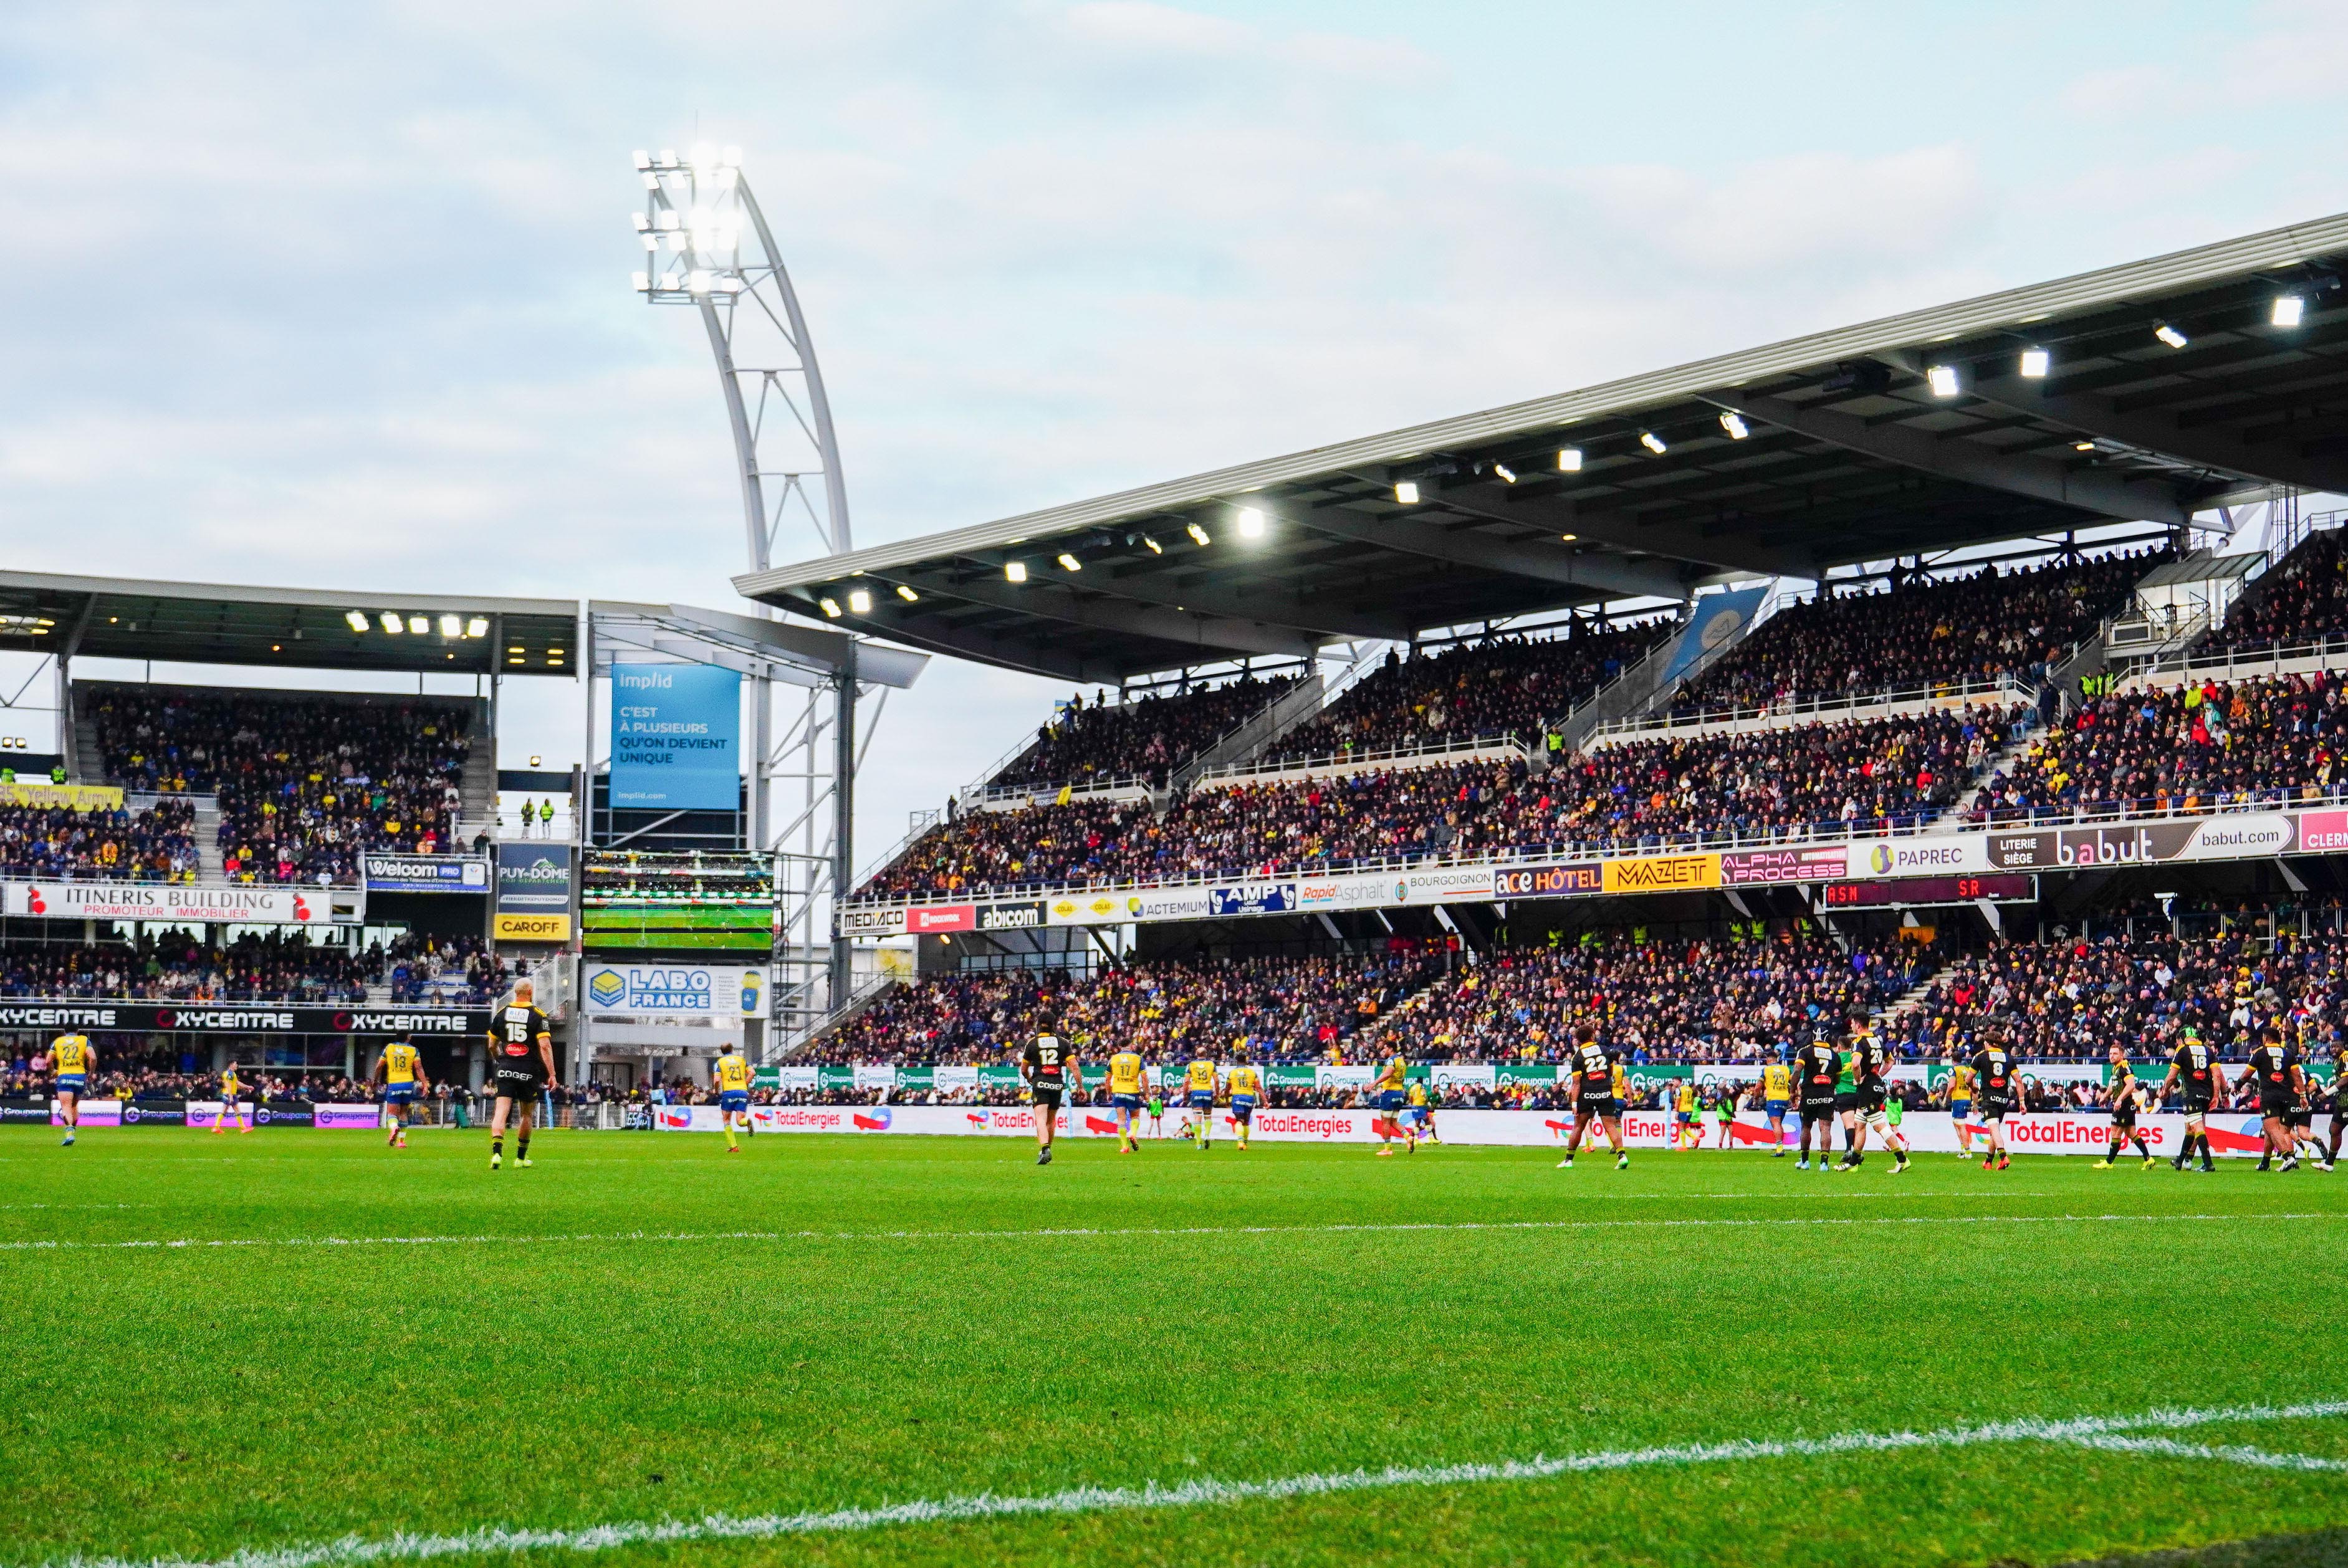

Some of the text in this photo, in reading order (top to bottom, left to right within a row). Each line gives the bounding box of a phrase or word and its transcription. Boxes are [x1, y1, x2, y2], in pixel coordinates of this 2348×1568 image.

[620, 672, 673, 688] implid
[620, 707, 658, 717] C'EST
[633, 724, 709, 734] PLUSIEURS
[620, 738, 727, 748] QU'ON DEVIENT
[620, 753, 673, 765] UNIQUE
[618, 791, 666, 800] implid.com
[2000, 839, 2037, 851] LITERIE
[2202, 830, 2279, 846] babut.com
[2057, 829, 2153, 865] babut
[1722, 851, 1796, 868] ALPHA
[1899, 848, 1962, 866] PAPREC
[2004, 851, 2033, 864] SIÈGE
[368, 860, 438, 877] Welcom
[1618, 858, 1707, 887] MAZET
[1734, 863, 1845, 882] PROCESS
[1411, 873, 1491, 887] BOURGOIGNON
[1497, 868, 1601, 894] ace HÔTEL
[1226, 886, 1278, 902] AMP
[1828, 886, 1857, 902] ASM
[1959, 880, 1978, 896] SR
[67, 889, 274, 909] ITINERIS BUILDING
[84, 905, 249, 918] PROMOTEUR IMMOBILIER
[1147, 901, 1207, 915] ACTEMIUM
[984, 906, 1038, 927] abicom
[502, 921, 559, 933] CAROFF
[630, 970, 710, 991] LABO
[630, 993, 710, 1008] FRANCE
[506, 1023, 527, 1042] 15
[63, 1046, 78, 1059] 22
[1039, 1049, 1058, 1065] 12
[1870, 1049, 1882, 1064] 20
[393, 1056, 406, 1068] 13
[1584, 1056, 1608, 1073] 22
[1819, 1059, 1829, 1073] 7
[1993, 1062, 2003, 1076] 8
[2192, 1055, 2207, 1069] 18
[2273, 1057, 2282, 1071] 5
[499, 1069, 532, 1081] COGEP
[729, 1066, 742, 1079] 21
[828, 1075, 854, 1084] Groupama
[868, 1075, 893, 1084] Groupama
[906, 1074, 933, 1084] Groupama
[947, 1074, 975, 1084] Groupama
[990, 1074, 1018, 1084] Groupama
[791, 1076, 815, 1084] Groupama
[1037, 1081, 1063, 1090] COGEP
[1278, 1074, 1315, 1086] Groupama
[1334, 1075, 1371, 1086] Groupama
[1451, 1076, 1491, 1088] Groupama
[1513, 1076, 1555, 1089] Groupama
[1773, 1075, 1786, 1086] 23
[1806, 1097, 1834, 1105] COGEP
[776, 1111, 840, 1129] TotalEnergies
[992, 1112, 1068, 1129] TotalEnes
[1256, 1115, 1351, 1138] TotalEnergies
